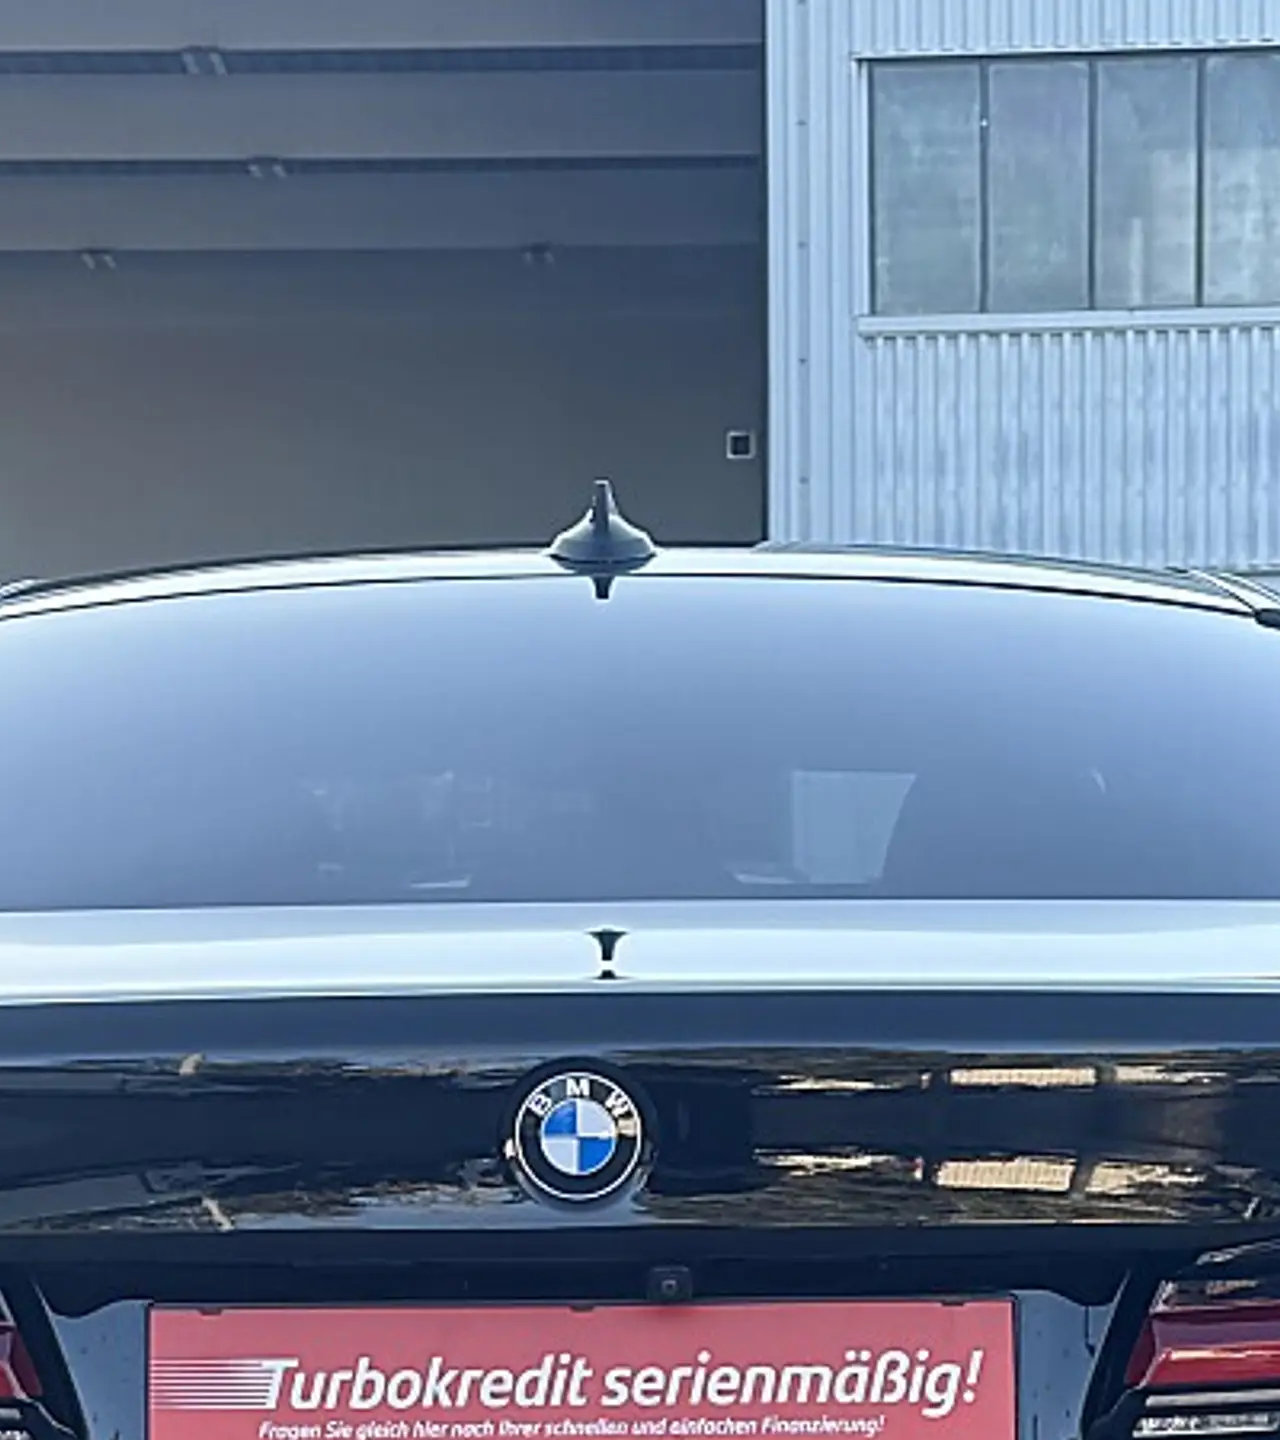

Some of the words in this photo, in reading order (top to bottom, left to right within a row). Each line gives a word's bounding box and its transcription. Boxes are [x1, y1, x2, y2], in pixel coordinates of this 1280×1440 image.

[528, 1078, 629, 1118] BMW
[261, 1353, 593, 1409] Turbokredit
[600, 1349, 983, 1419] serienmäßig!
[324, 1420, 353, 1440] Sie
[412, 1419, 448, 1438] hier
[451, 1419, 495, 1438] nach
[499, 1419, 539, 1437] Ihrer
[544, 1416, 627, 1436] schnellen
[631, 1416, 665, 1435] und
[669, 1416, 757, 1434] einfachen
[761, 1414, 886, 1438] Finanzierung!
